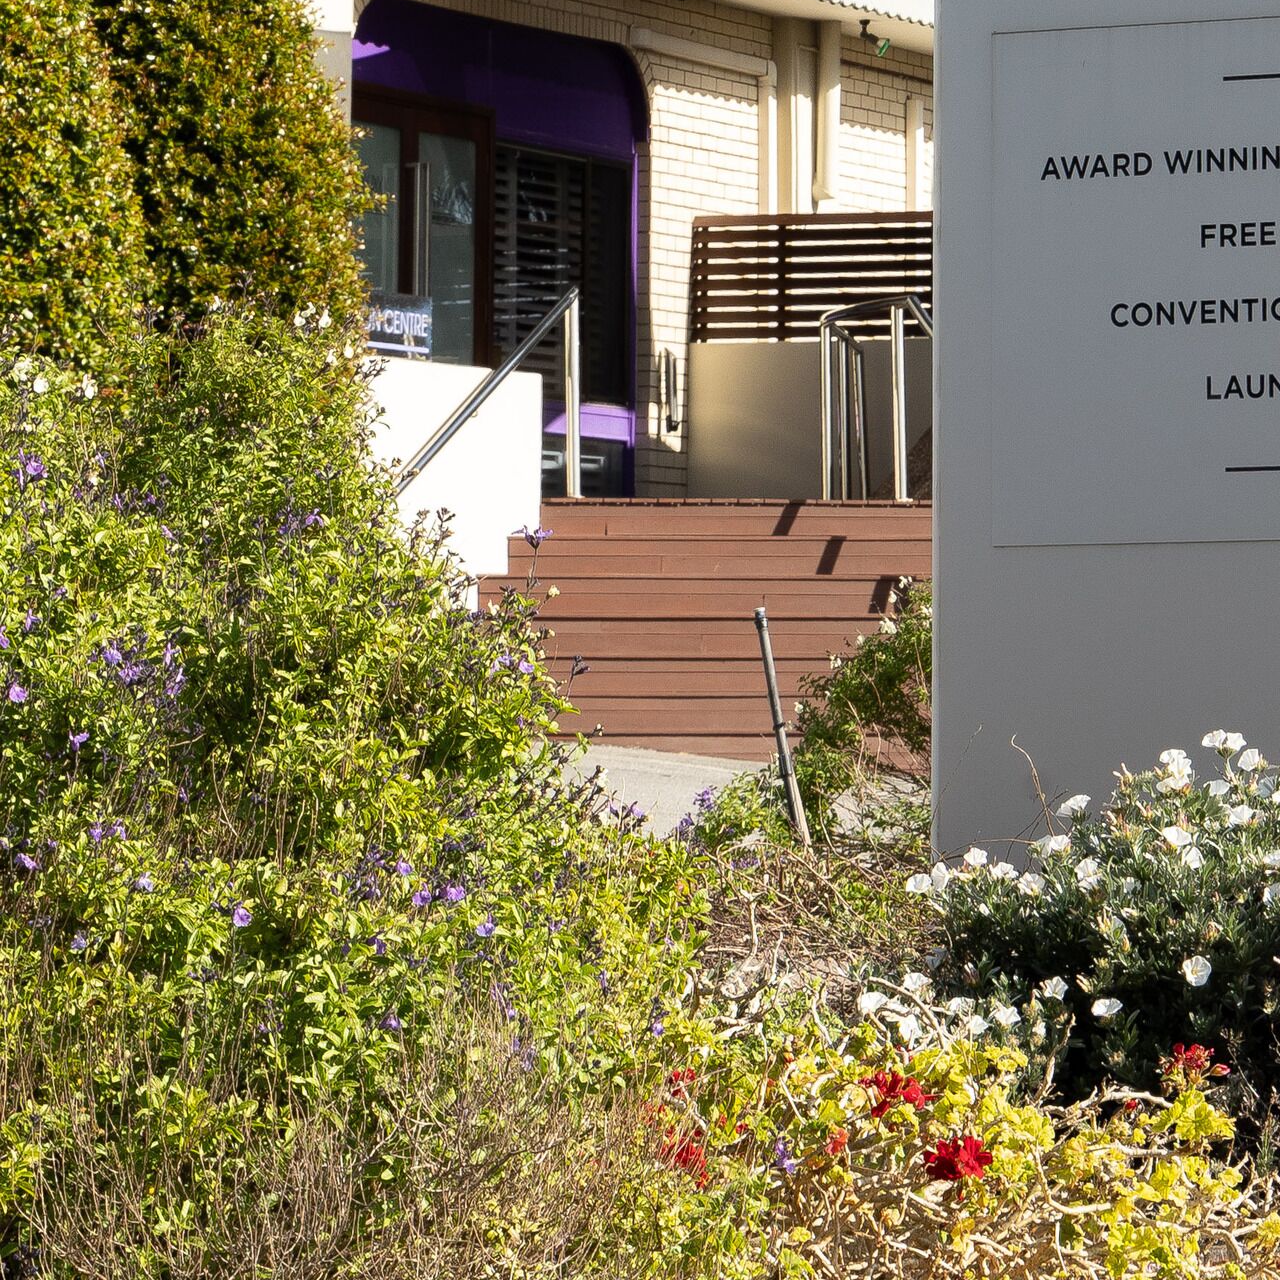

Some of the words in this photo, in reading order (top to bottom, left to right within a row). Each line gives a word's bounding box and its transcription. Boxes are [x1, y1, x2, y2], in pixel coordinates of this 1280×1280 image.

[1040, 152, 1153, 181] AWARD
[1200, 221, 1277, 249] FREE
[383, 309, 429, 337] CENTRE
